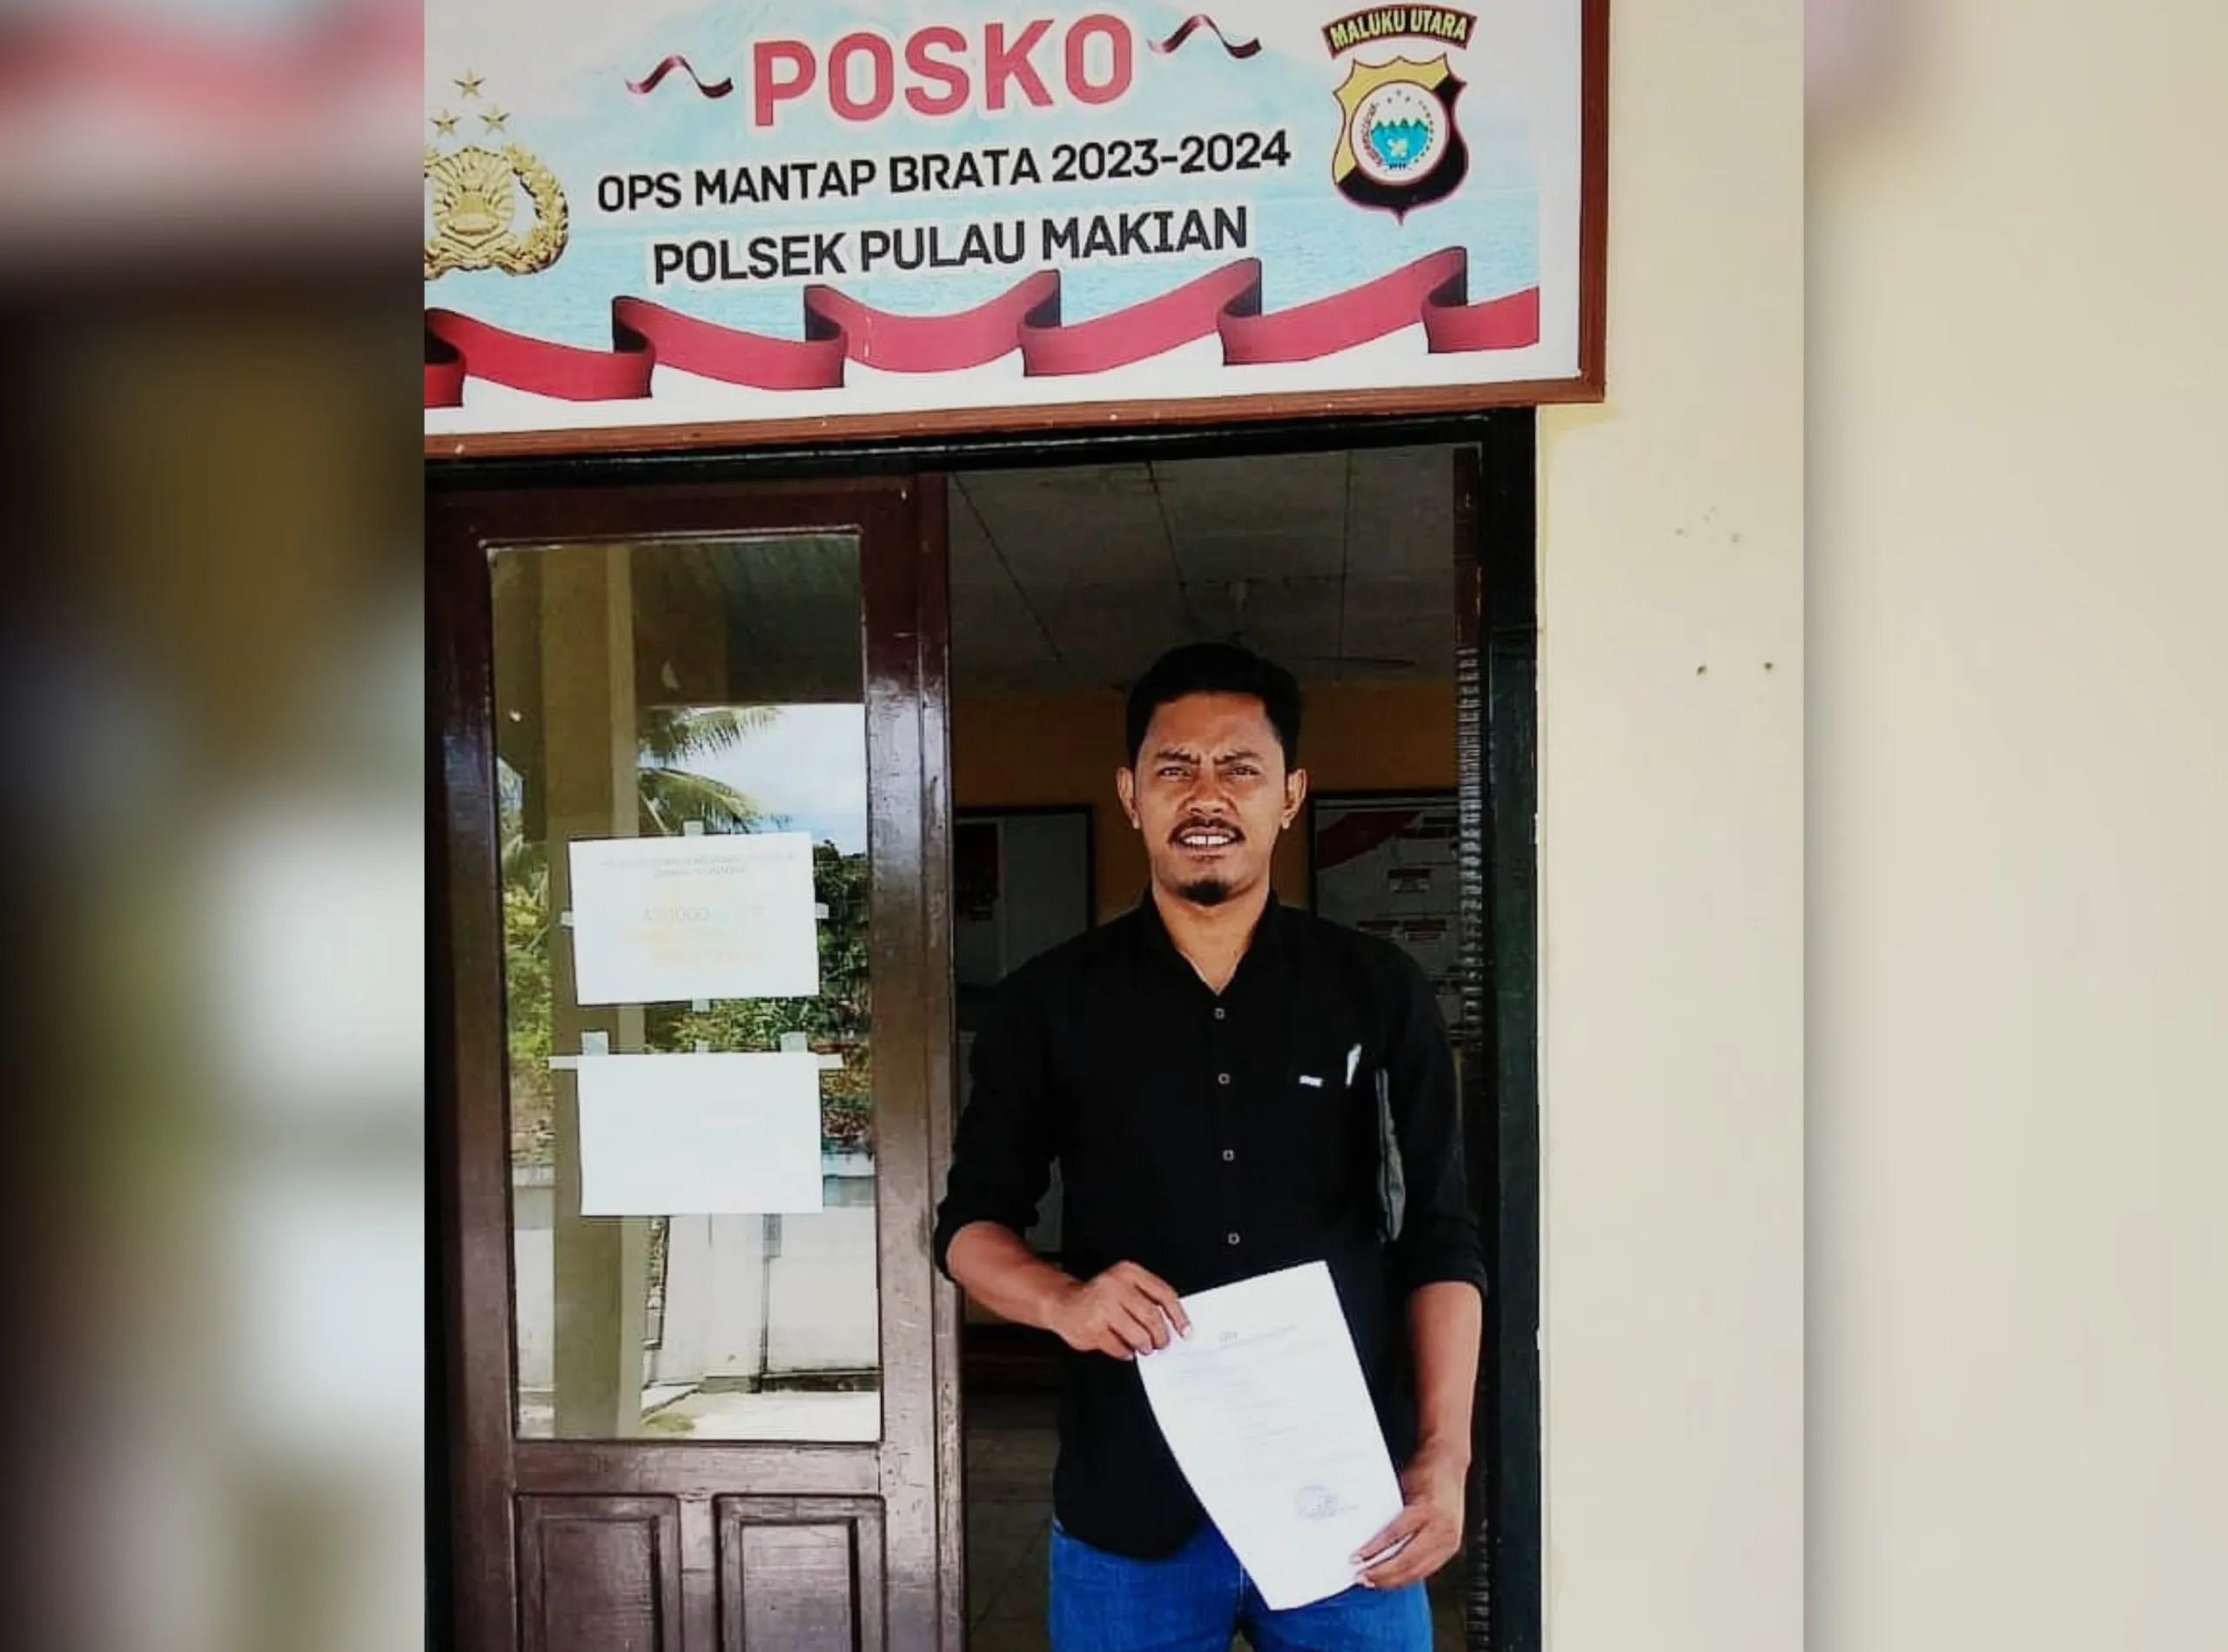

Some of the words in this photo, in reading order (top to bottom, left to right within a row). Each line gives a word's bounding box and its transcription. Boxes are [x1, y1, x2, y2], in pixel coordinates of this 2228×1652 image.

[1330, 9, 1406, 49] MALUKU
[1410, 9, 1467, 40] UTARA
[753, 13, 1133, 127] POSKO
[598, 171, 681, 212] OPS
[695, 159, 876, 206] MANTAP
[889, 147, 1041, 193] BRATA
[1051, 130, 1291, 183] 2023-2024
[654, 232, 846, 285] POLSEK
[860, 219, 1024, 272] PULAU
[1042, 205, 1248, 261] MAKIAN
